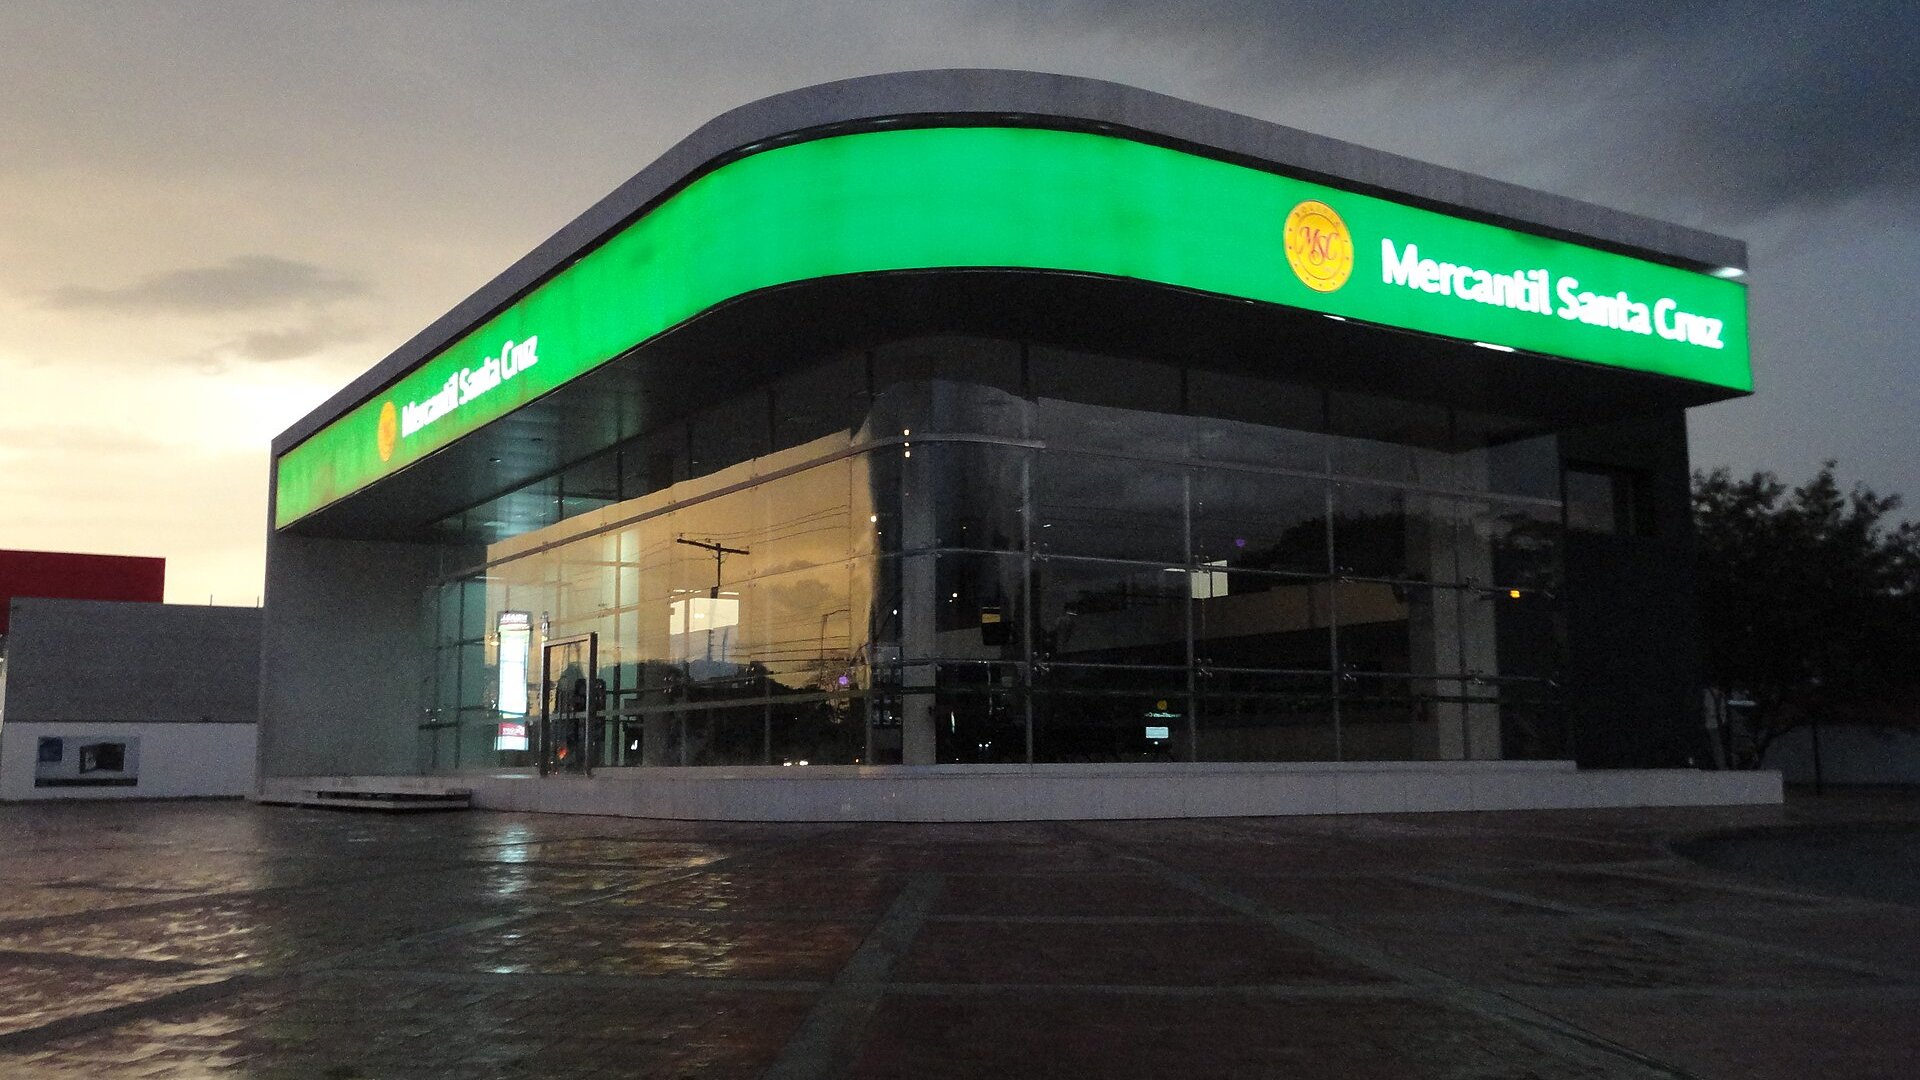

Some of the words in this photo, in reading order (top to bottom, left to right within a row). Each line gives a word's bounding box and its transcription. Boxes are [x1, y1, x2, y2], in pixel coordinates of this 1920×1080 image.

[1381, 238, 1553, 316] Mercantil
[1556, 276, 1653, 335] Santa
[1653, 297, 1725, 350] Cruz
[458, 355, 501, 405] Santa
[500, 335, 539, 381] Cruz
